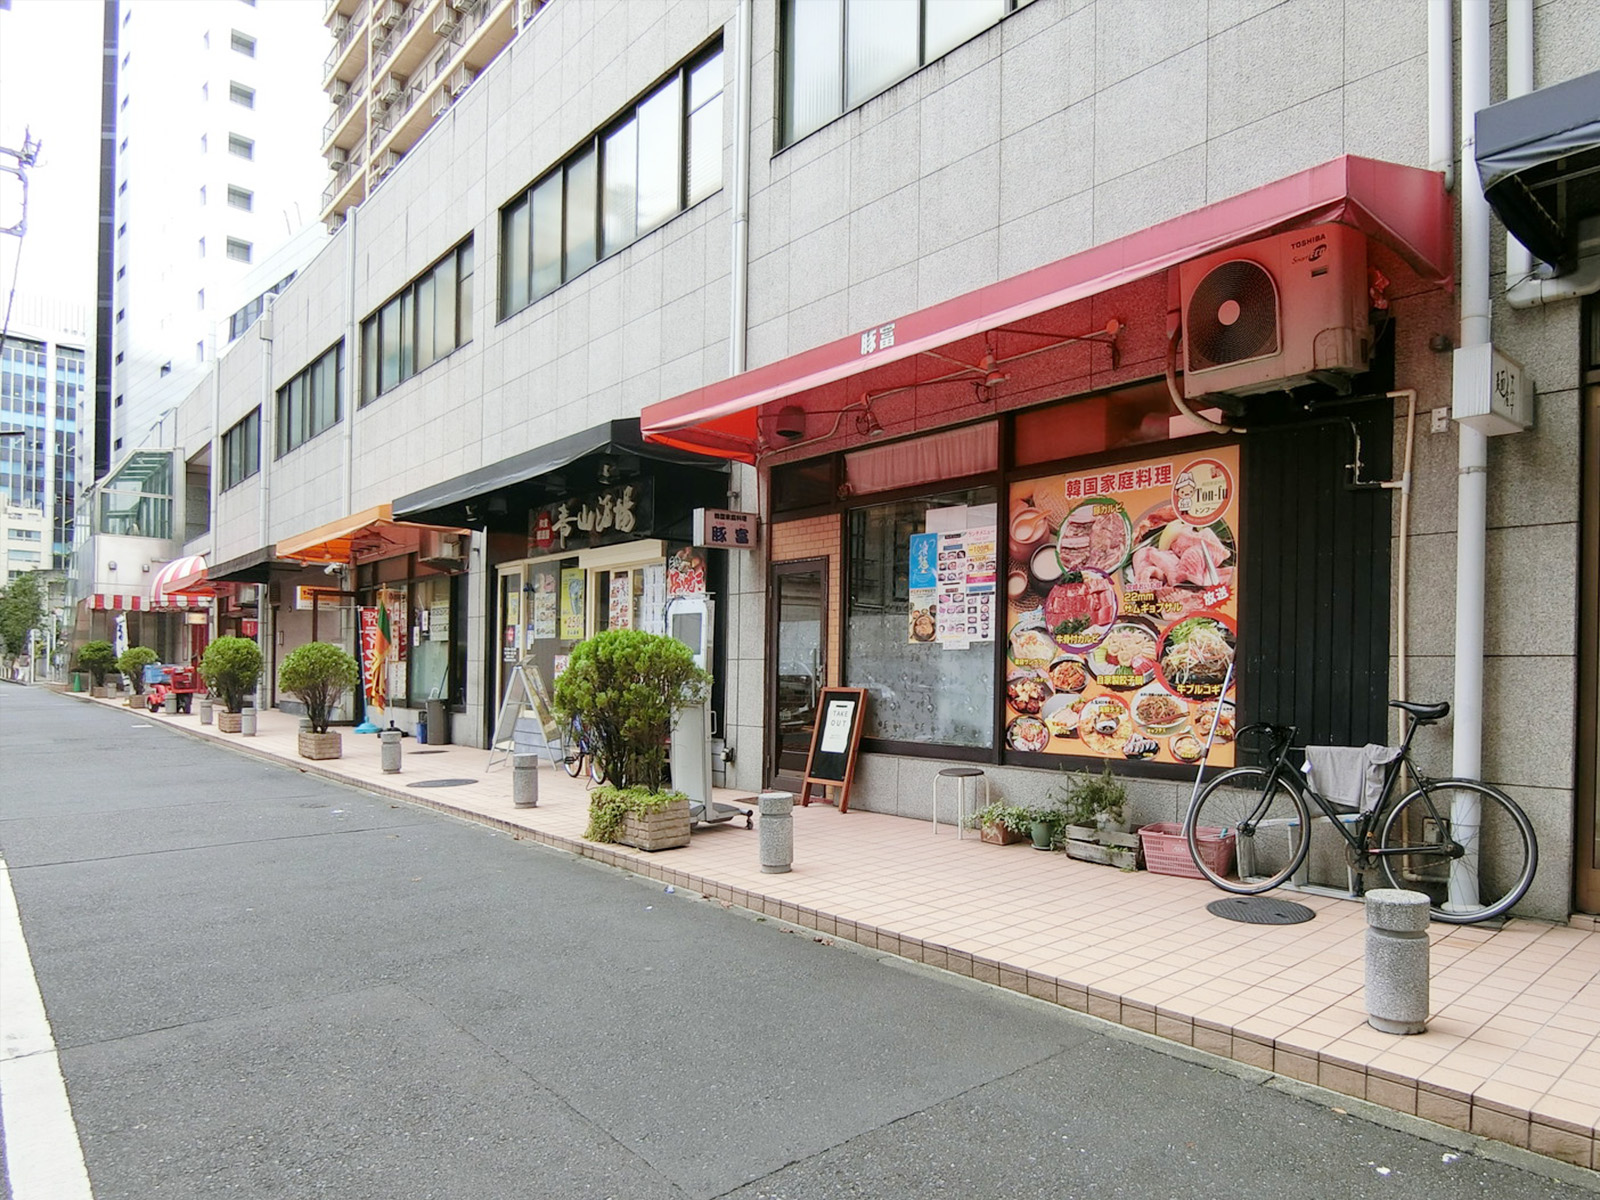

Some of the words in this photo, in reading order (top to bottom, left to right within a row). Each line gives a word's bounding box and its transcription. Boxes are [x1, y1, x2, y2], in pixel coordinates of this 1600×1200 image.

[1291, 233, 1326, 249] TOSHIBA
[860, 322, 896, 355] 豚富
[1066, 464, 1172, 498] 韓国家庭料理
[1195, 485, 1228, 502] Ton-fu
[1123, 592, 1155, 602] 22mm
[1176, 684, 1221, 695] 牛ブルコギ
